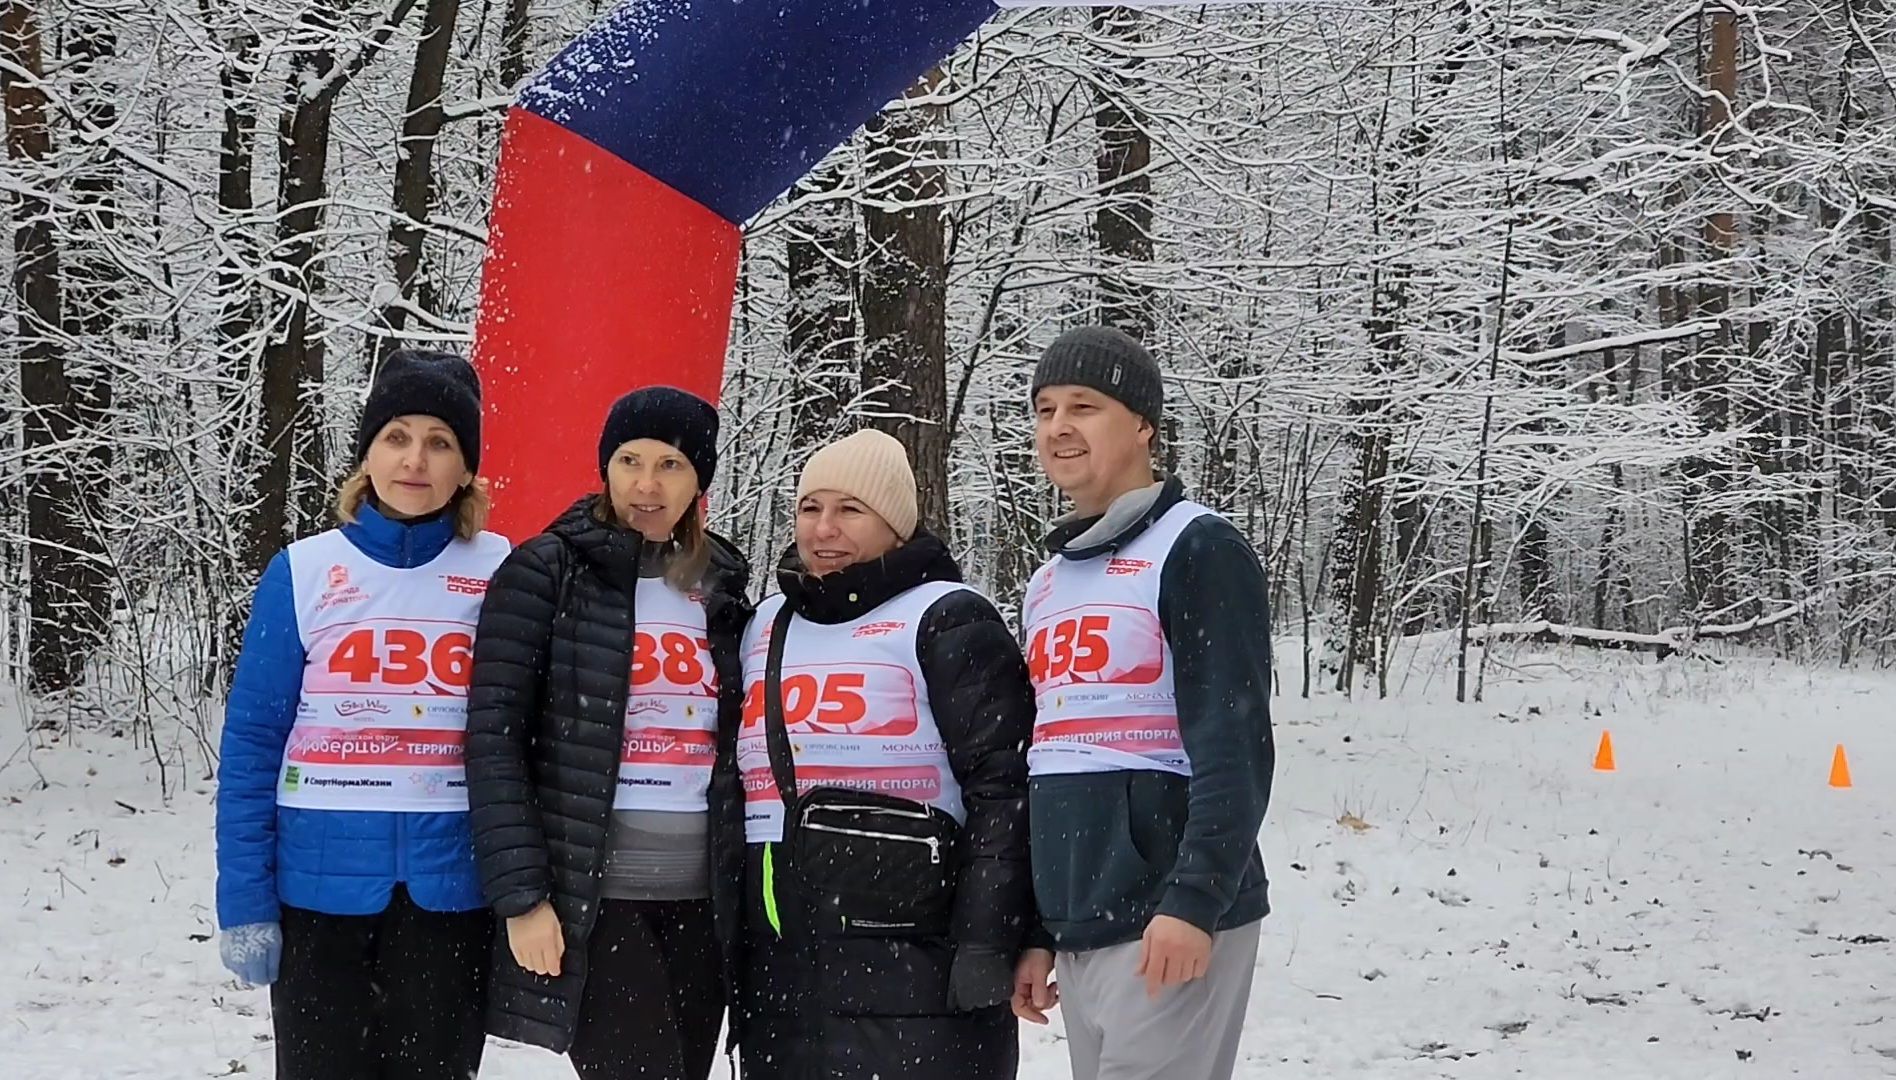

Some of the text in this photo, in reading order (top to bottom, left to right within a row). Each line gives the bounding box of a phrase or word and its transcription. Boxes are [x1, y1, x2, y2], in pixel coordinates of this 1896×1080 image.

[446, 575, 490, 587] МОСО
[1028, 616, 1111, 684] 435
[328, 628, 473, 687] 436
[743, 673, 866, 729] 405
[1124, 729, 1179, 741] СПОРТА
[881, 743, 922, 751] MONA
[796, 778, 937, 790] ЕРРИТОРИЯ СПОРТА
